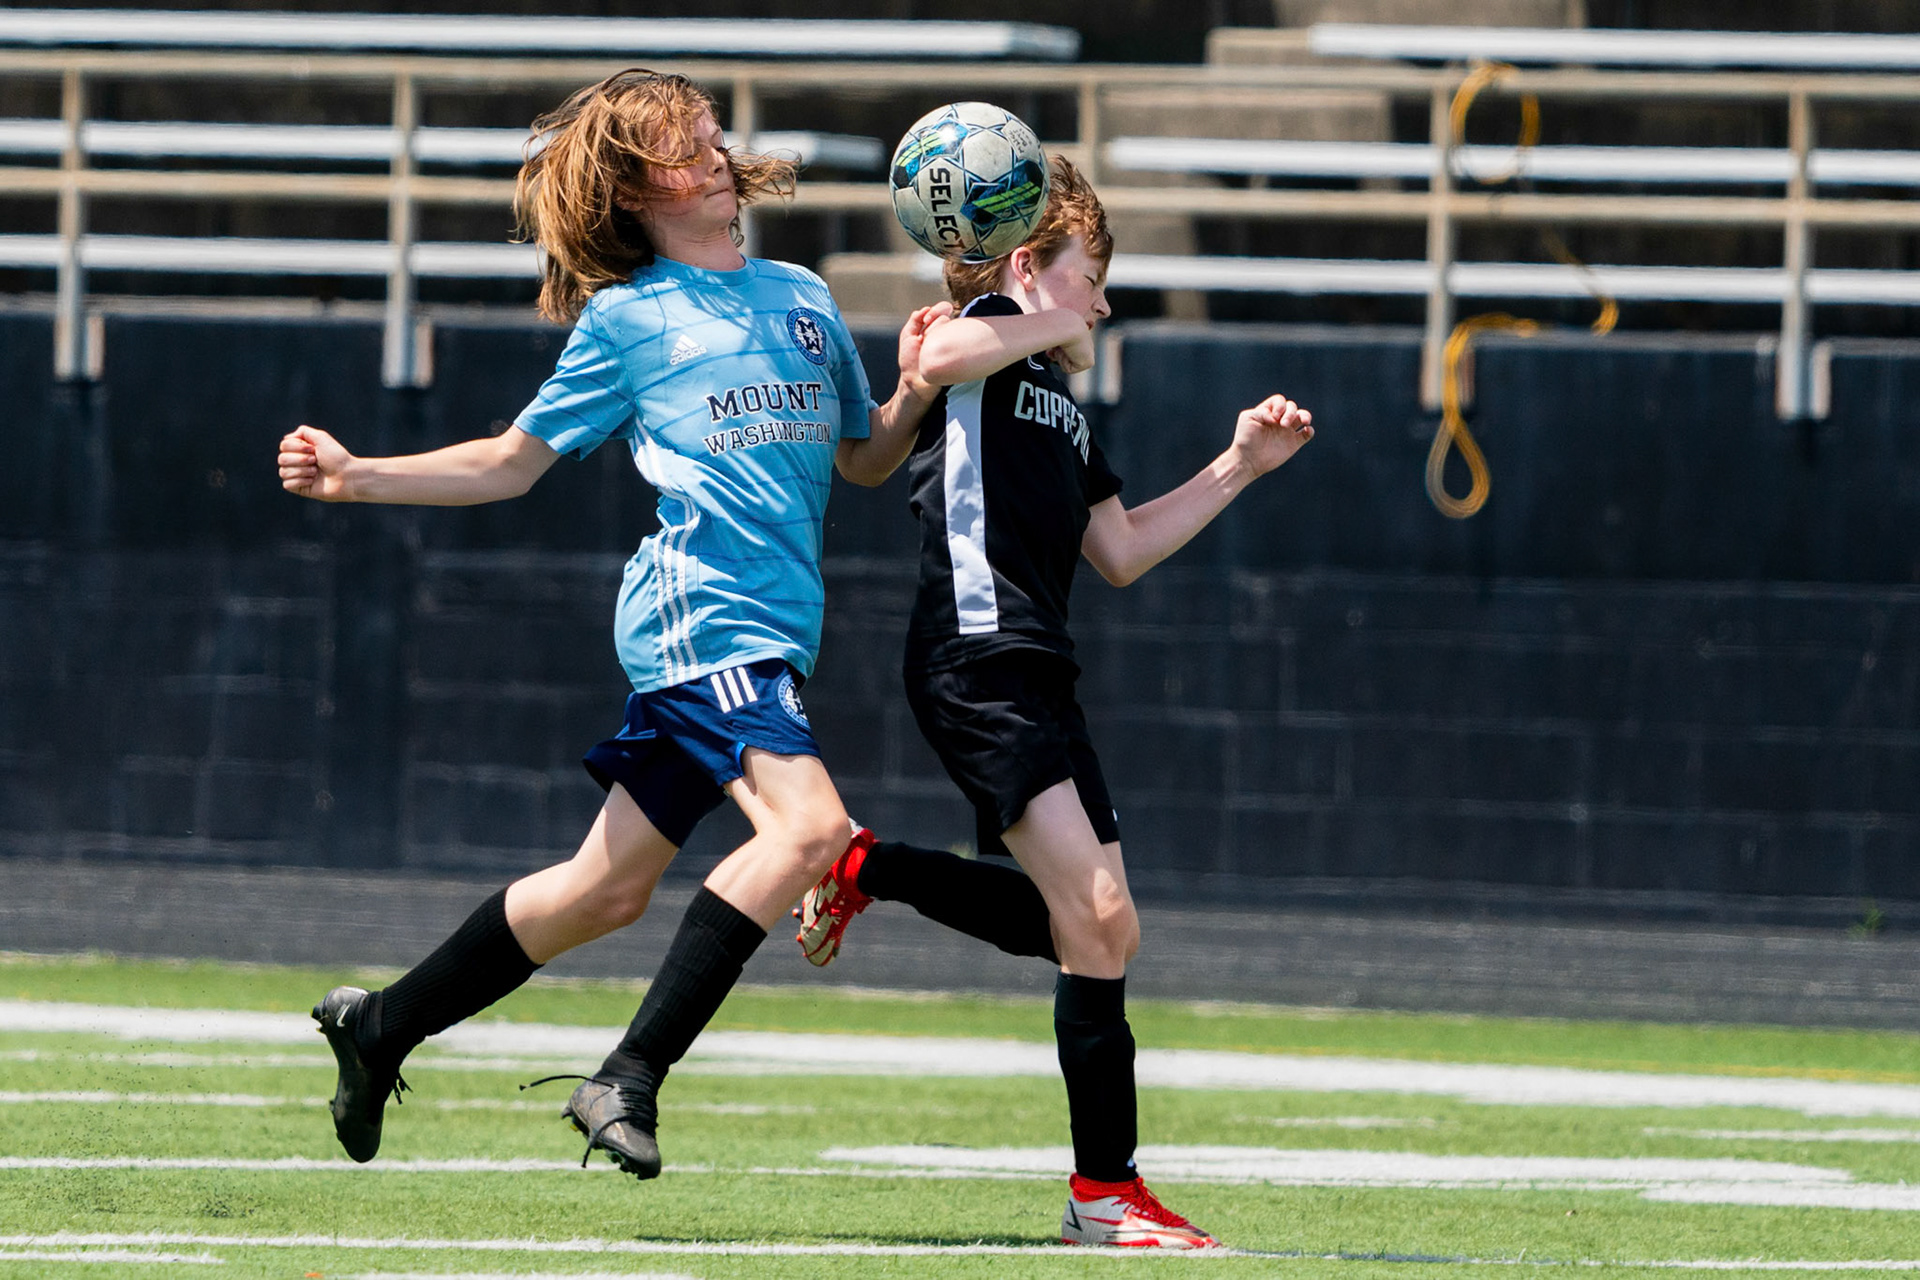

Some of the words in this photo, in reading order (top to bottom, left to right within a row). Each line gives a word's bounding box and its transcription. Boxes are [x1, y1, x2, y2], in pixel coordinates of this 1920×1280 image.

[930, 167, 966, 249] SELECT
[670, 345, 708, 366] adidas
[705, 383, 822, 422] MOUNT
[703, 422, 831, 456] WASHINGTON
